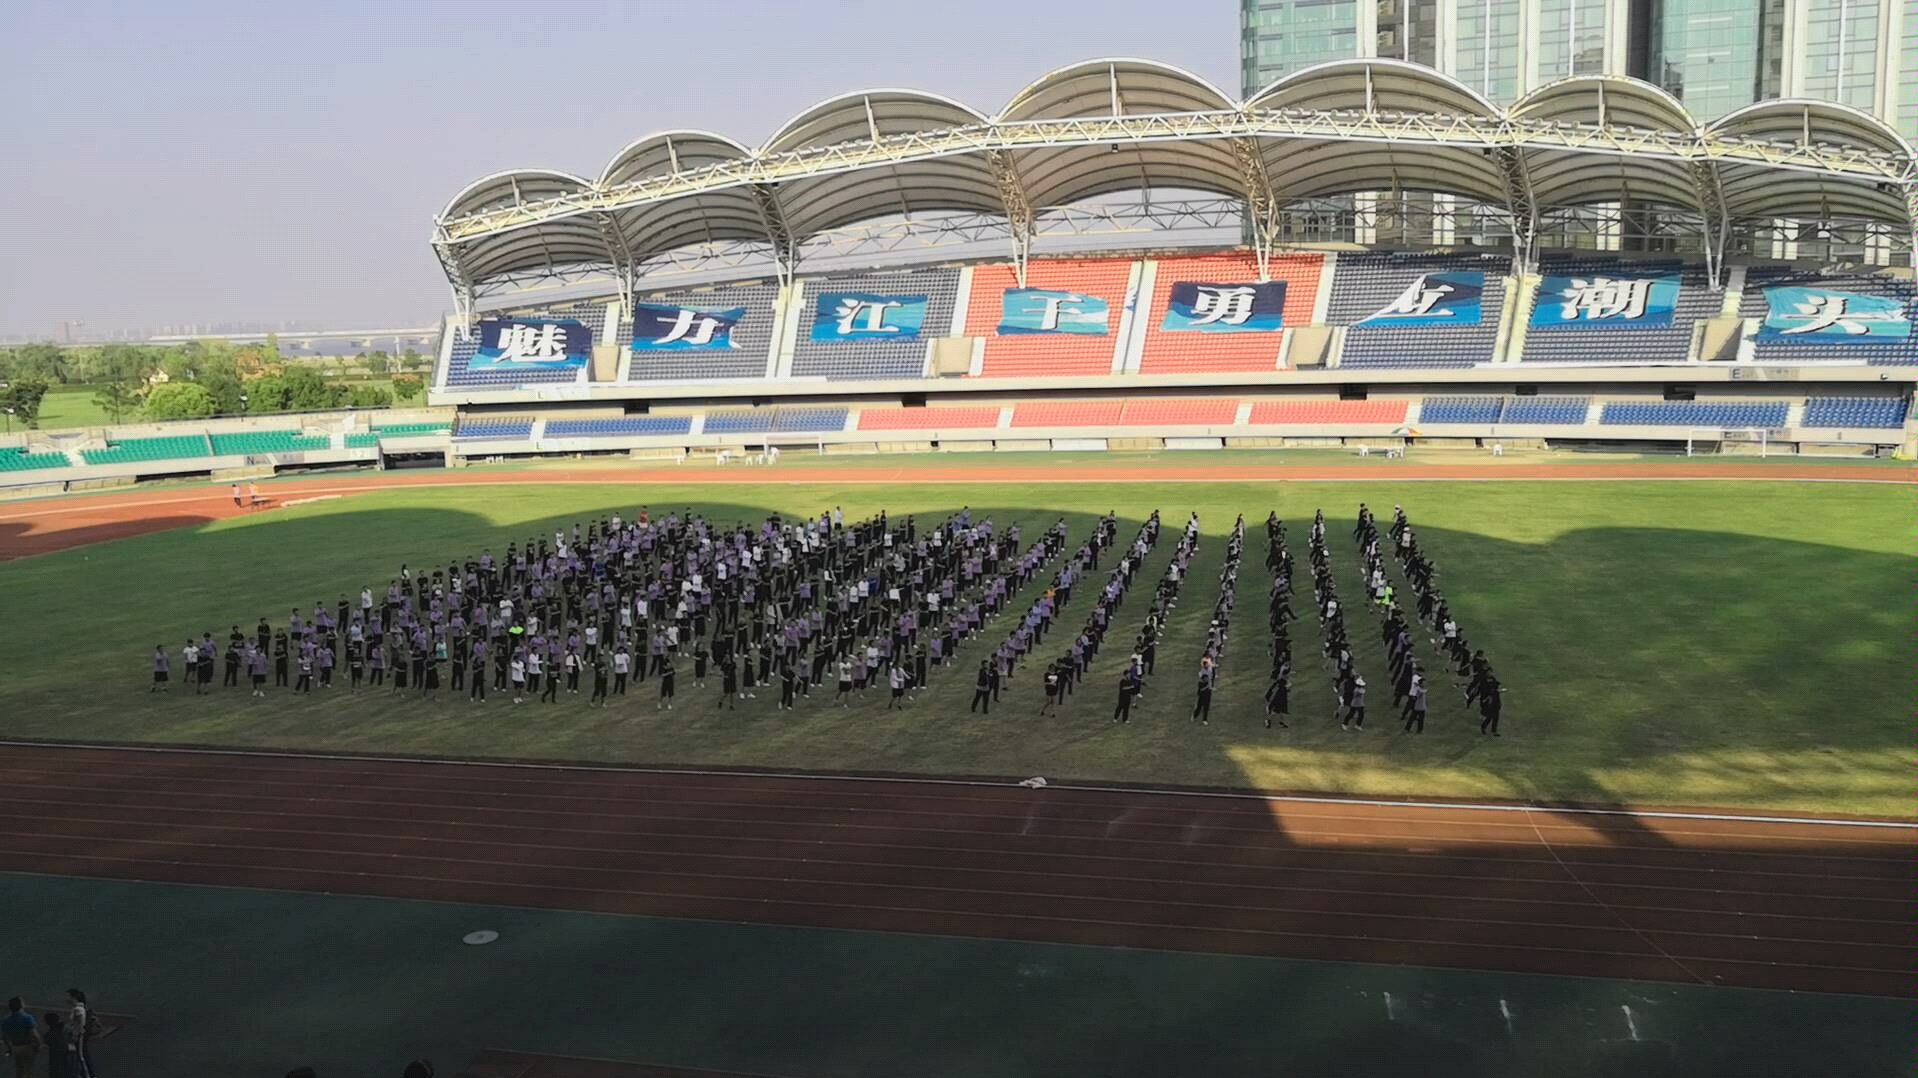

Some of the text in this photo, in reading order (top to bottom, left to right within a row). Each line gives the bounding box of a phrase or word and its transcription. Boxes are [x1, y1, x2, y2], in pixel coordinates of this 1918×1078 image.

[493, 324, 568, 362] 魅
[652, 310, 725, 345] 力
[833, 298, 903, 335] 江
[1021, 295, 1084, 330] 干
[1188, 286, 1256, 325] 勇
[1557, 278, 1652, 320] 潮
[1779, 295, 1884, 335] 头
